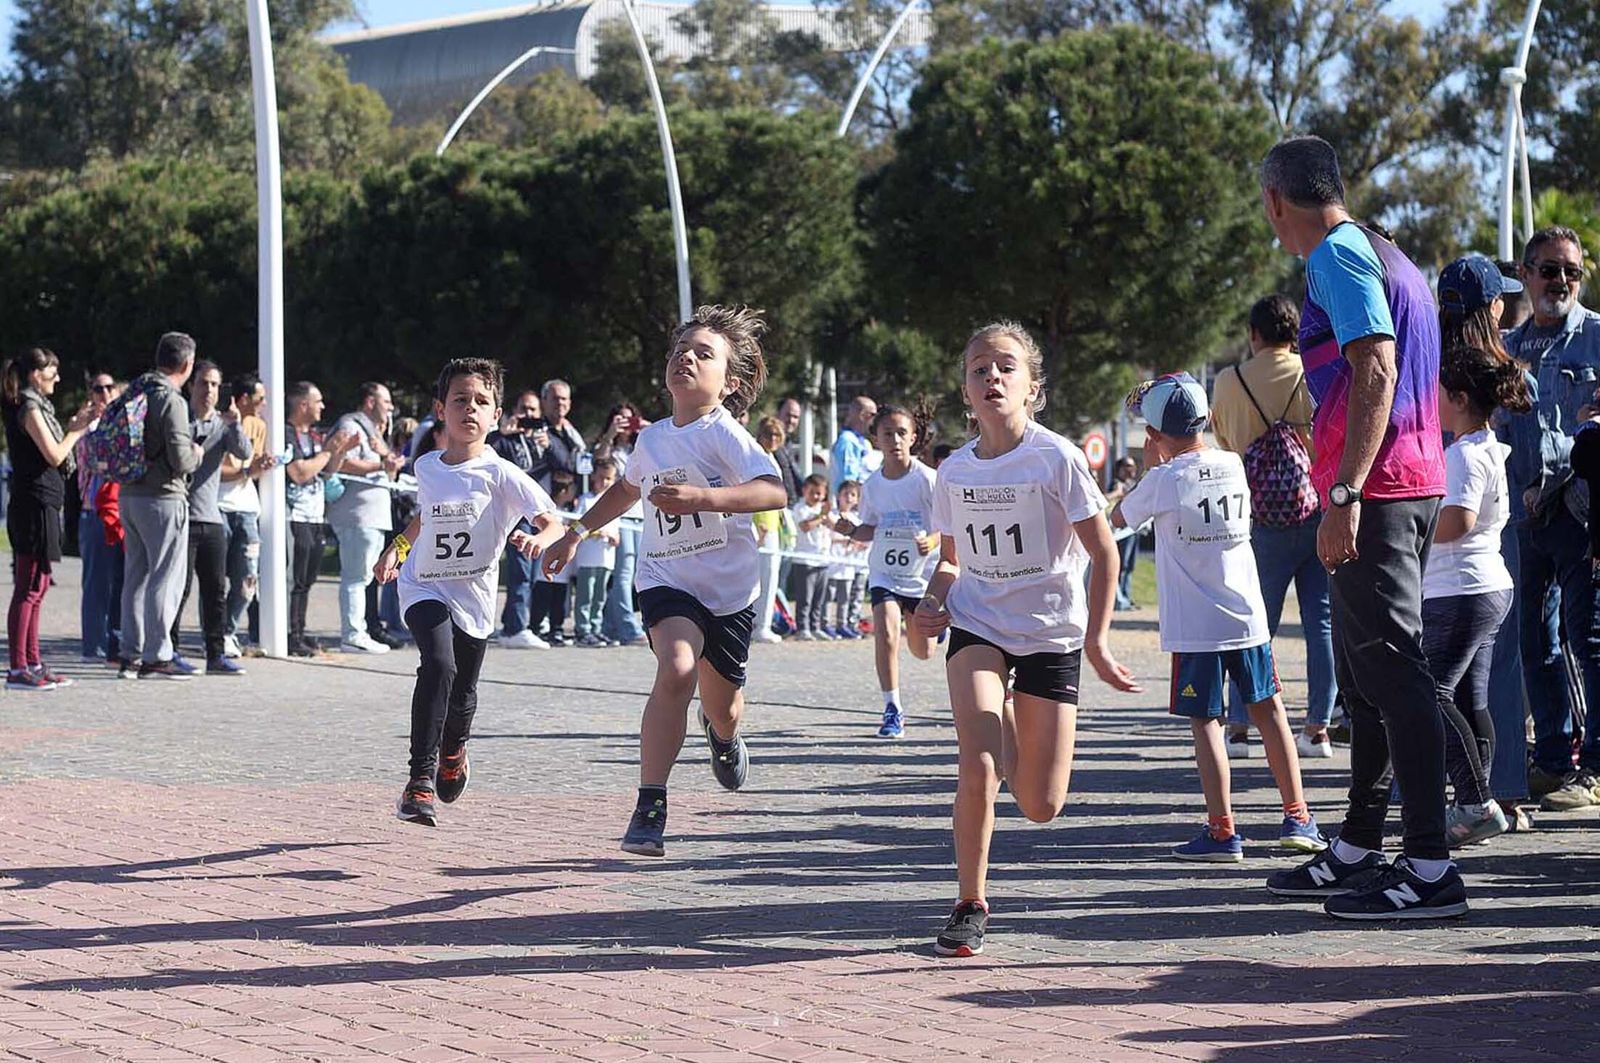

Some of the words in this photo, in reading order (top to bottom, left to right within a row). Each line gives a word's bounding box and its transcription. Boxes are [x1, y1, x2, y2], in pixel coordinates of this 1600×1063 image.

[963, 488, 975, 500] H
[1197, 493, 1244, 524] 117
[434, 532, 474, 560] 52
[965, 523, 1024, 556] 111
[885, 549, 910, 566] 66
[1308, 861, 1336, 887] N
[1383, 882, 1421, 909] N
